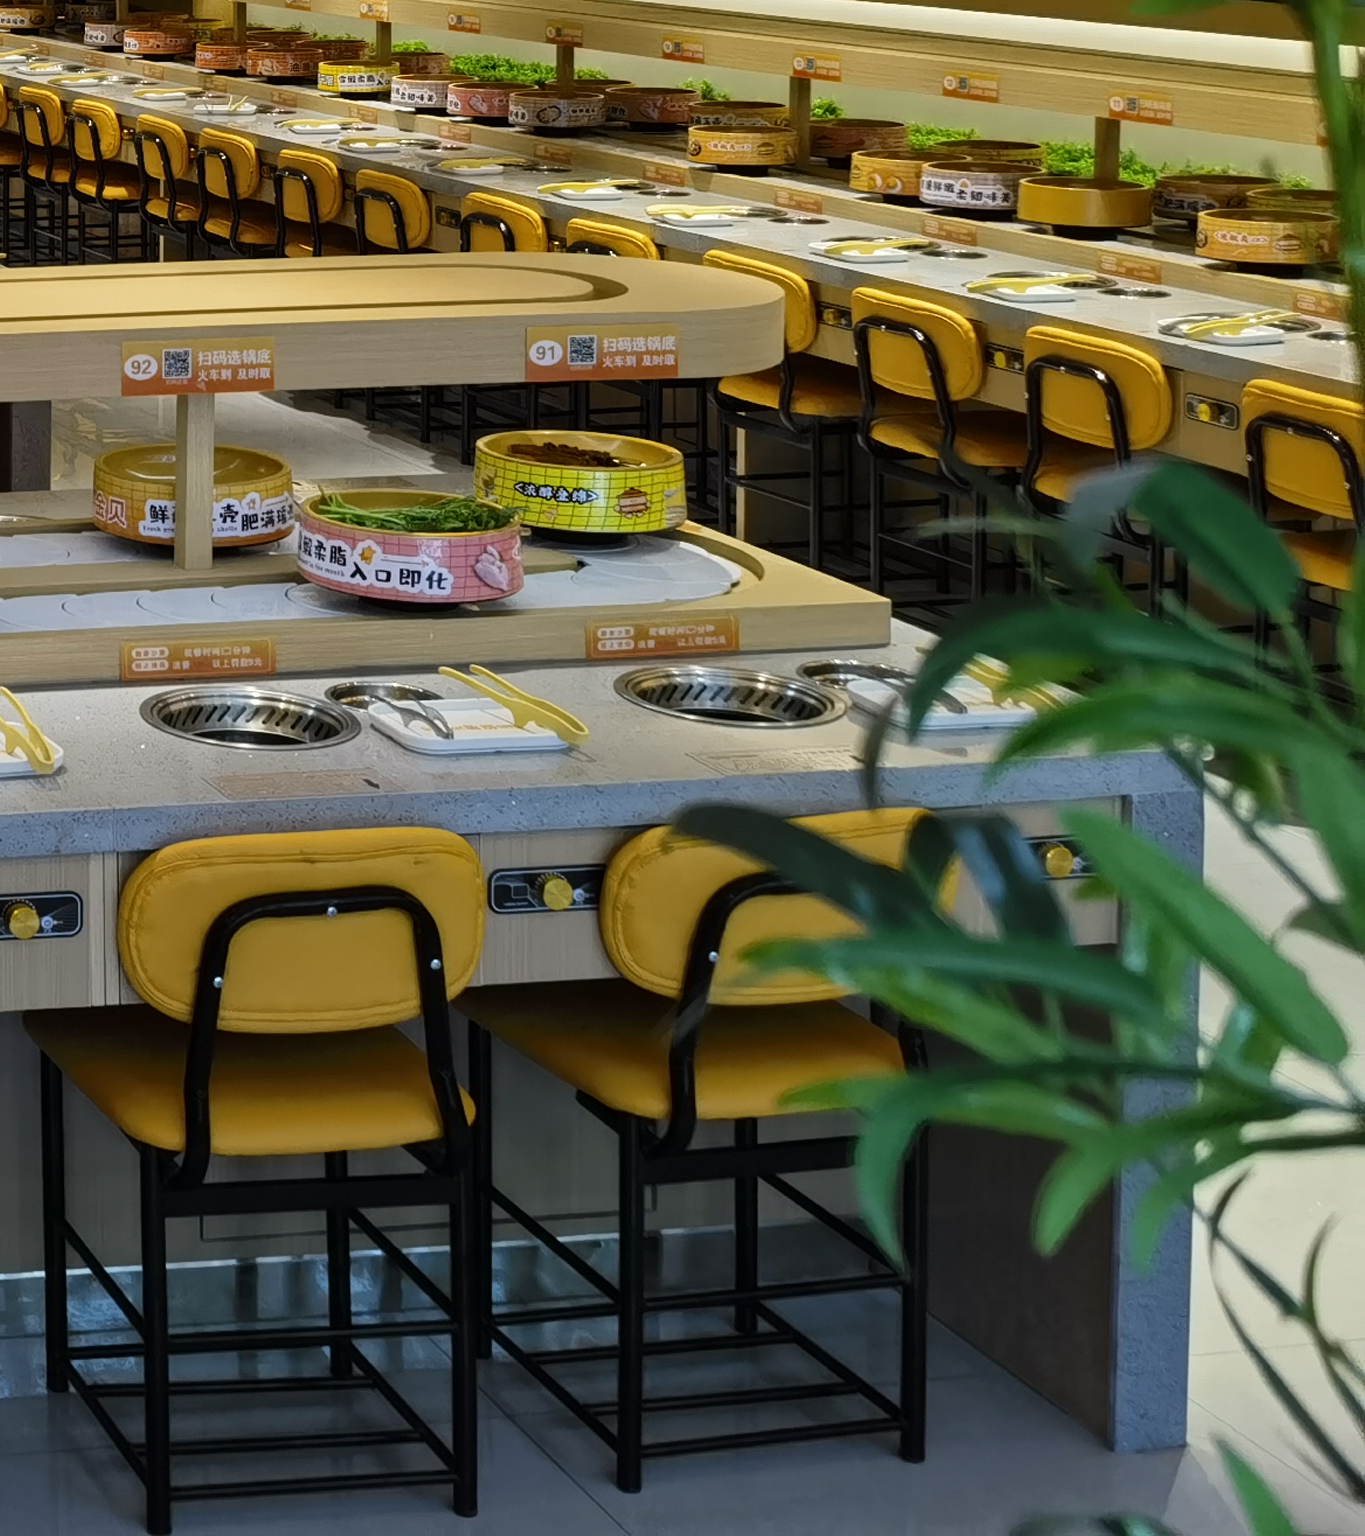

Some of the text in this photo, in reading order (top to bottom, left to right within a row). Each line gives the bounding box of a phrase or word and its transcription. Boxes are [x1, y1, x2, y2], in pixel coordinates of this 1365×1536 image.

[602, 335, 676, 352] 扫码选锅底
[197, 349, 272, 366] 扫码选锅底
[535, 345, 556, 361] 91
[131, 360, 152, 375] 92
[197, 369, 232, 382] 火车到
[350, 562, 448, 591] 入口即化
